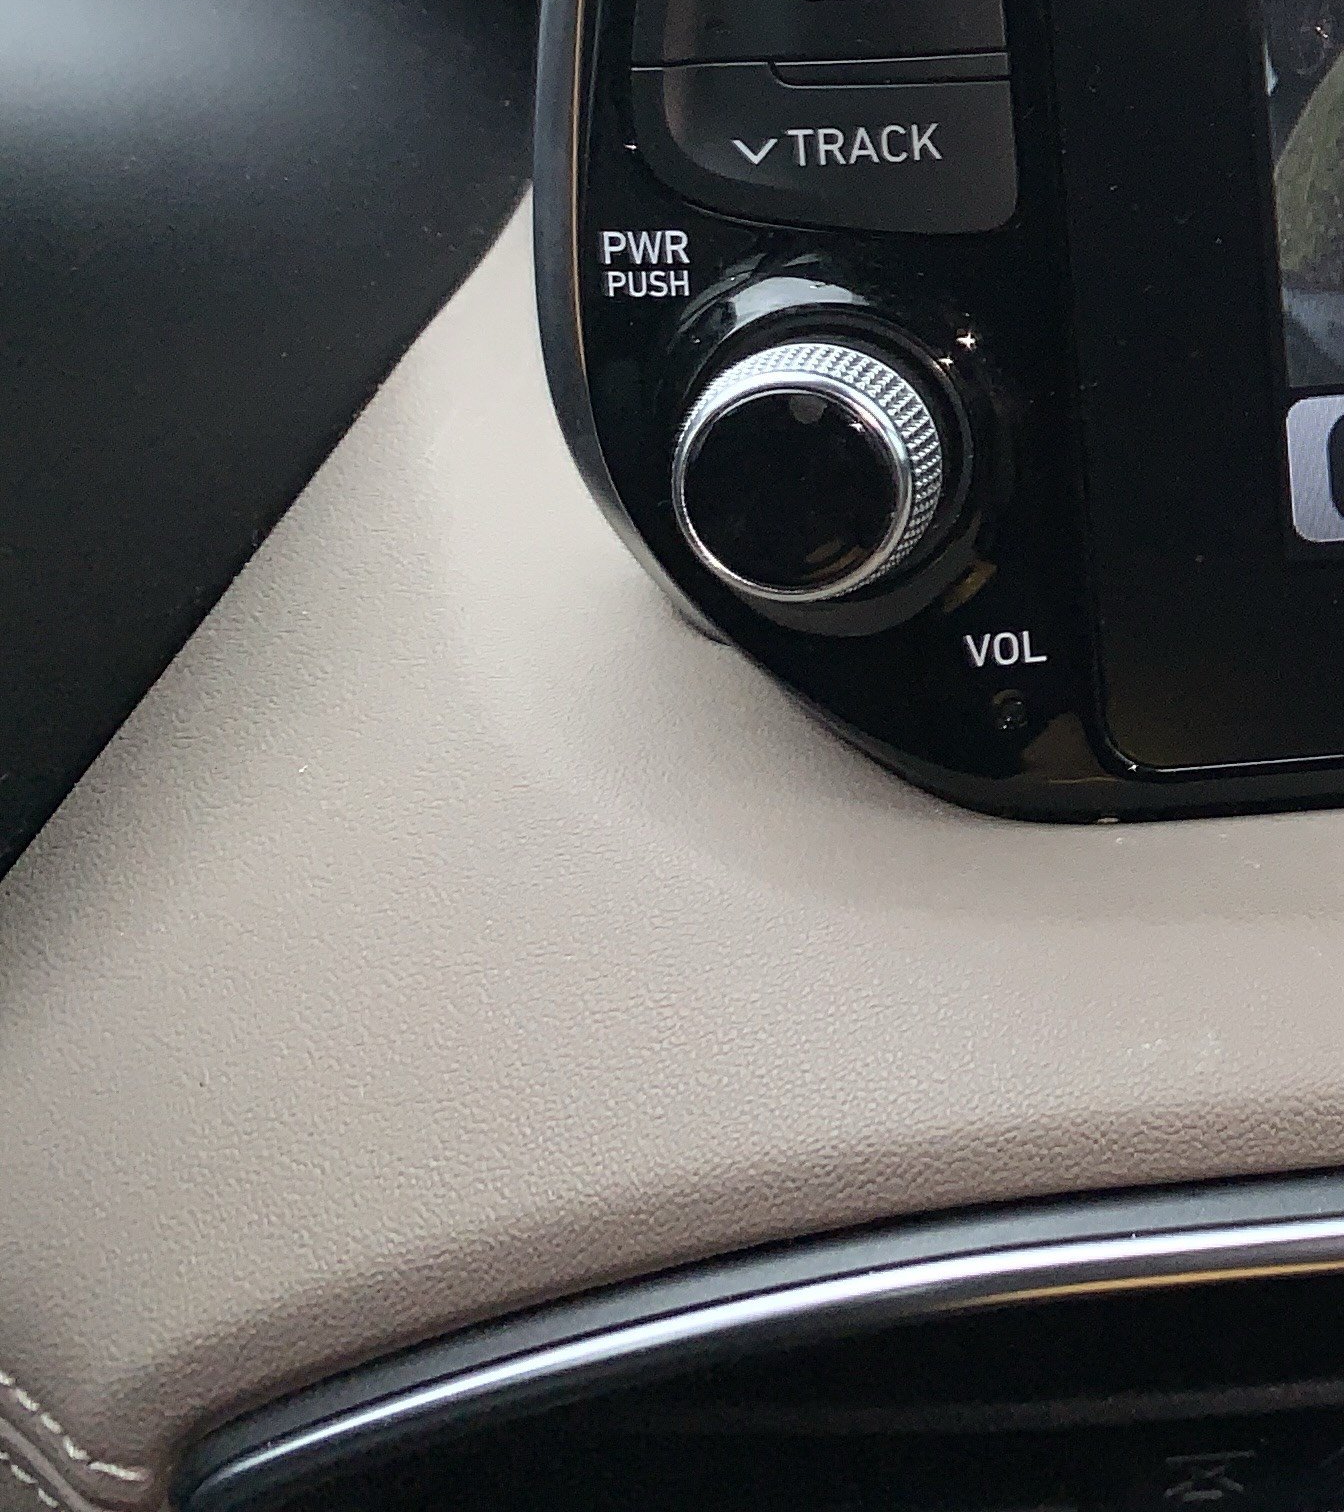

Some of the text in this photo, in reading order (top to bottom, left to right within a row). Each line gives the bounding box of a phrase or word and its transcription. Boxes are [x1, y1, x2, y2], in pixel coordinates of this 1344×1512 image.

[787, 122, 943, 168] TRACK
[601, 229, 691, 266] PWR
[606, 269, 691, 298] PUSH
[964, 629, 1049, 668] VOL
